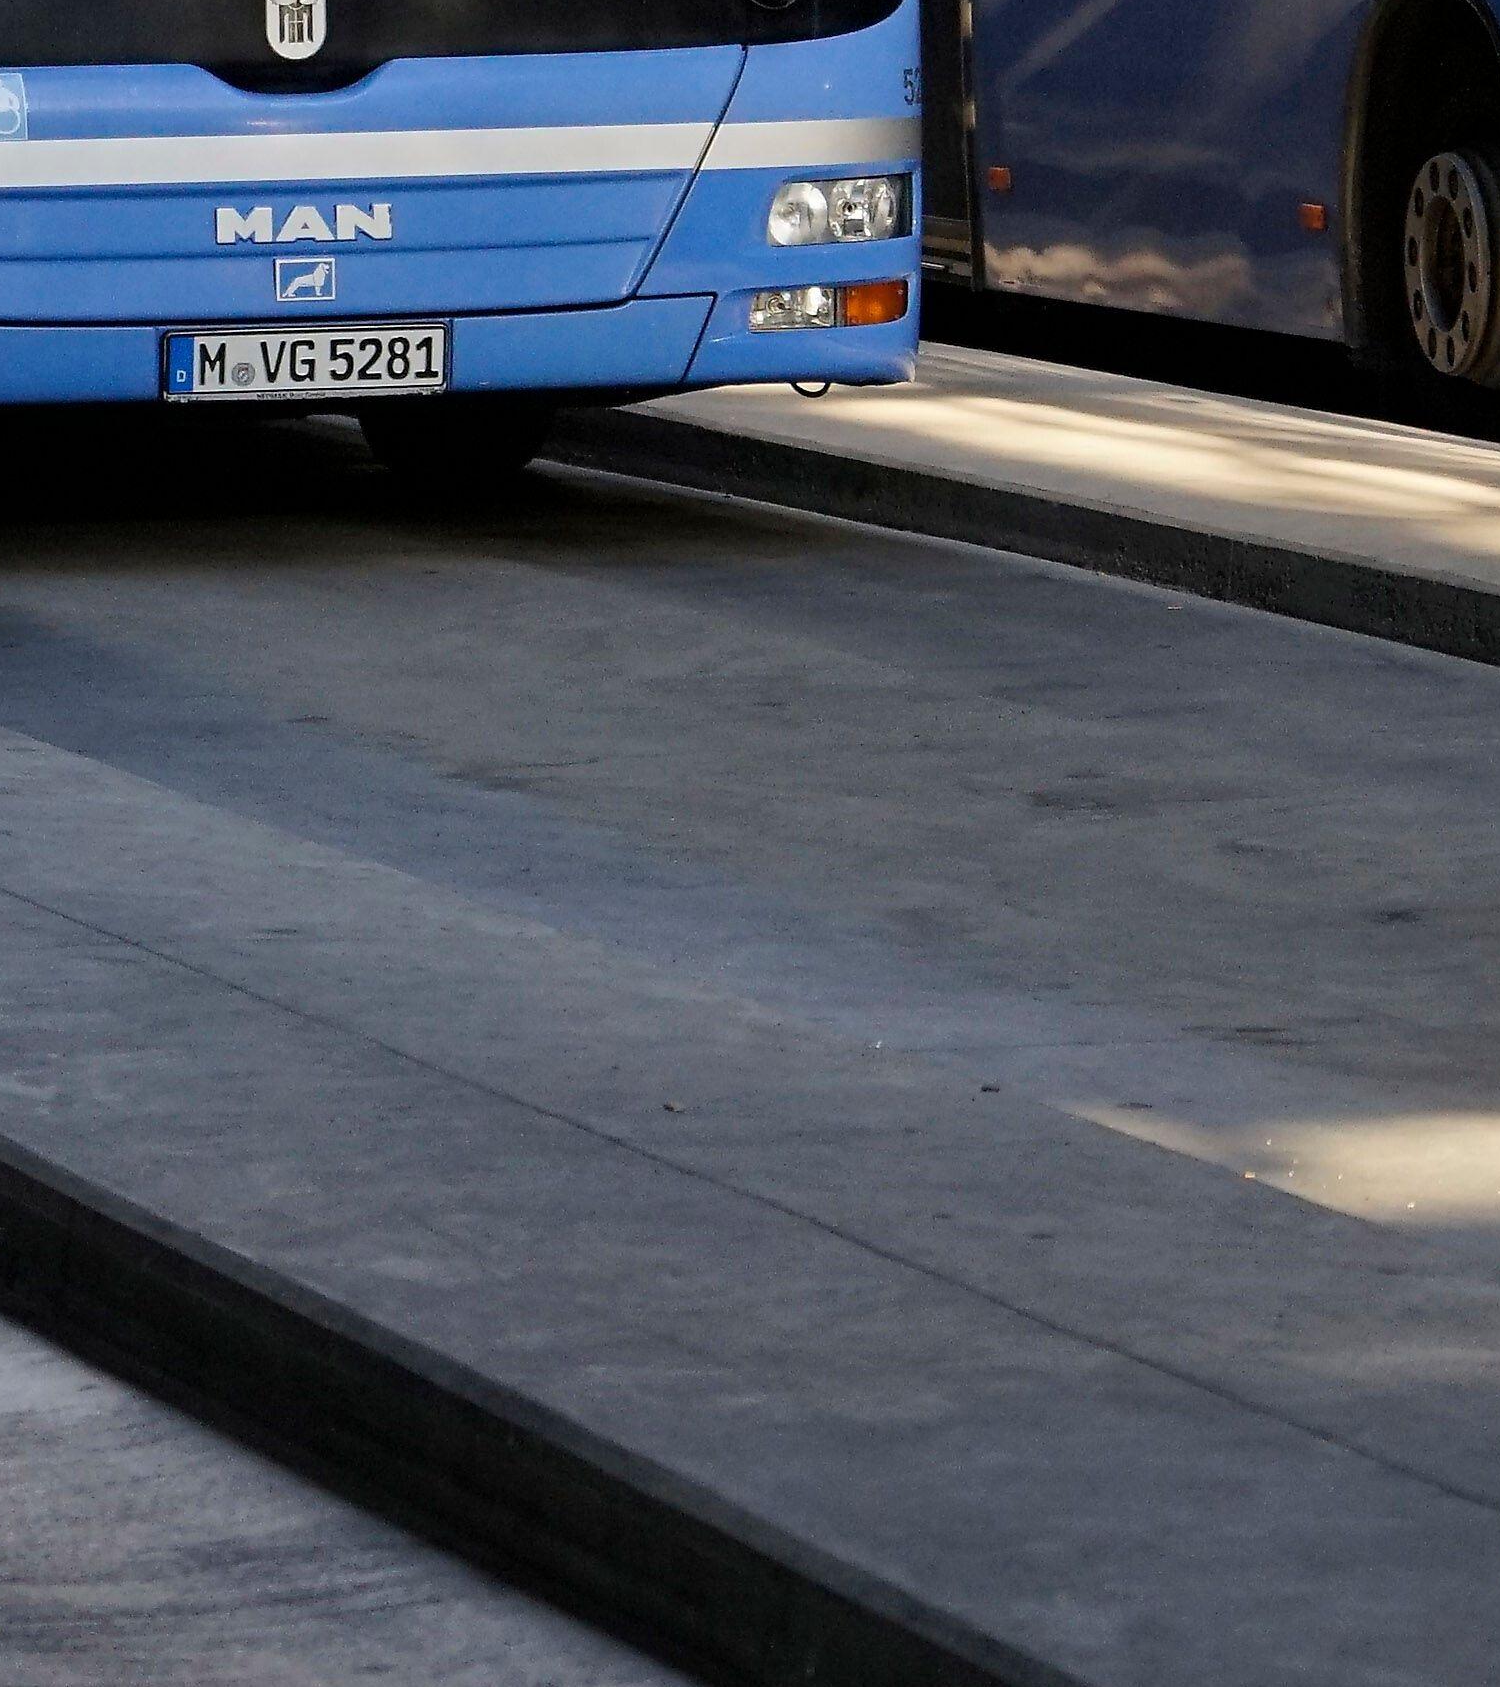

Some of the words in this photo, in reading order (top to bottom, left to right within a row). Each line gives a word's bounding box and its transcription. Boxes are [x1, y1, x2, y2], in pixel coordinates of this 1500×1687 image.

[216, 203, 393, 244] MAN
[199, 342, 227, 385] M
[260, 340, 315, 383] VG
[330, 336, 439, 380] 5281
